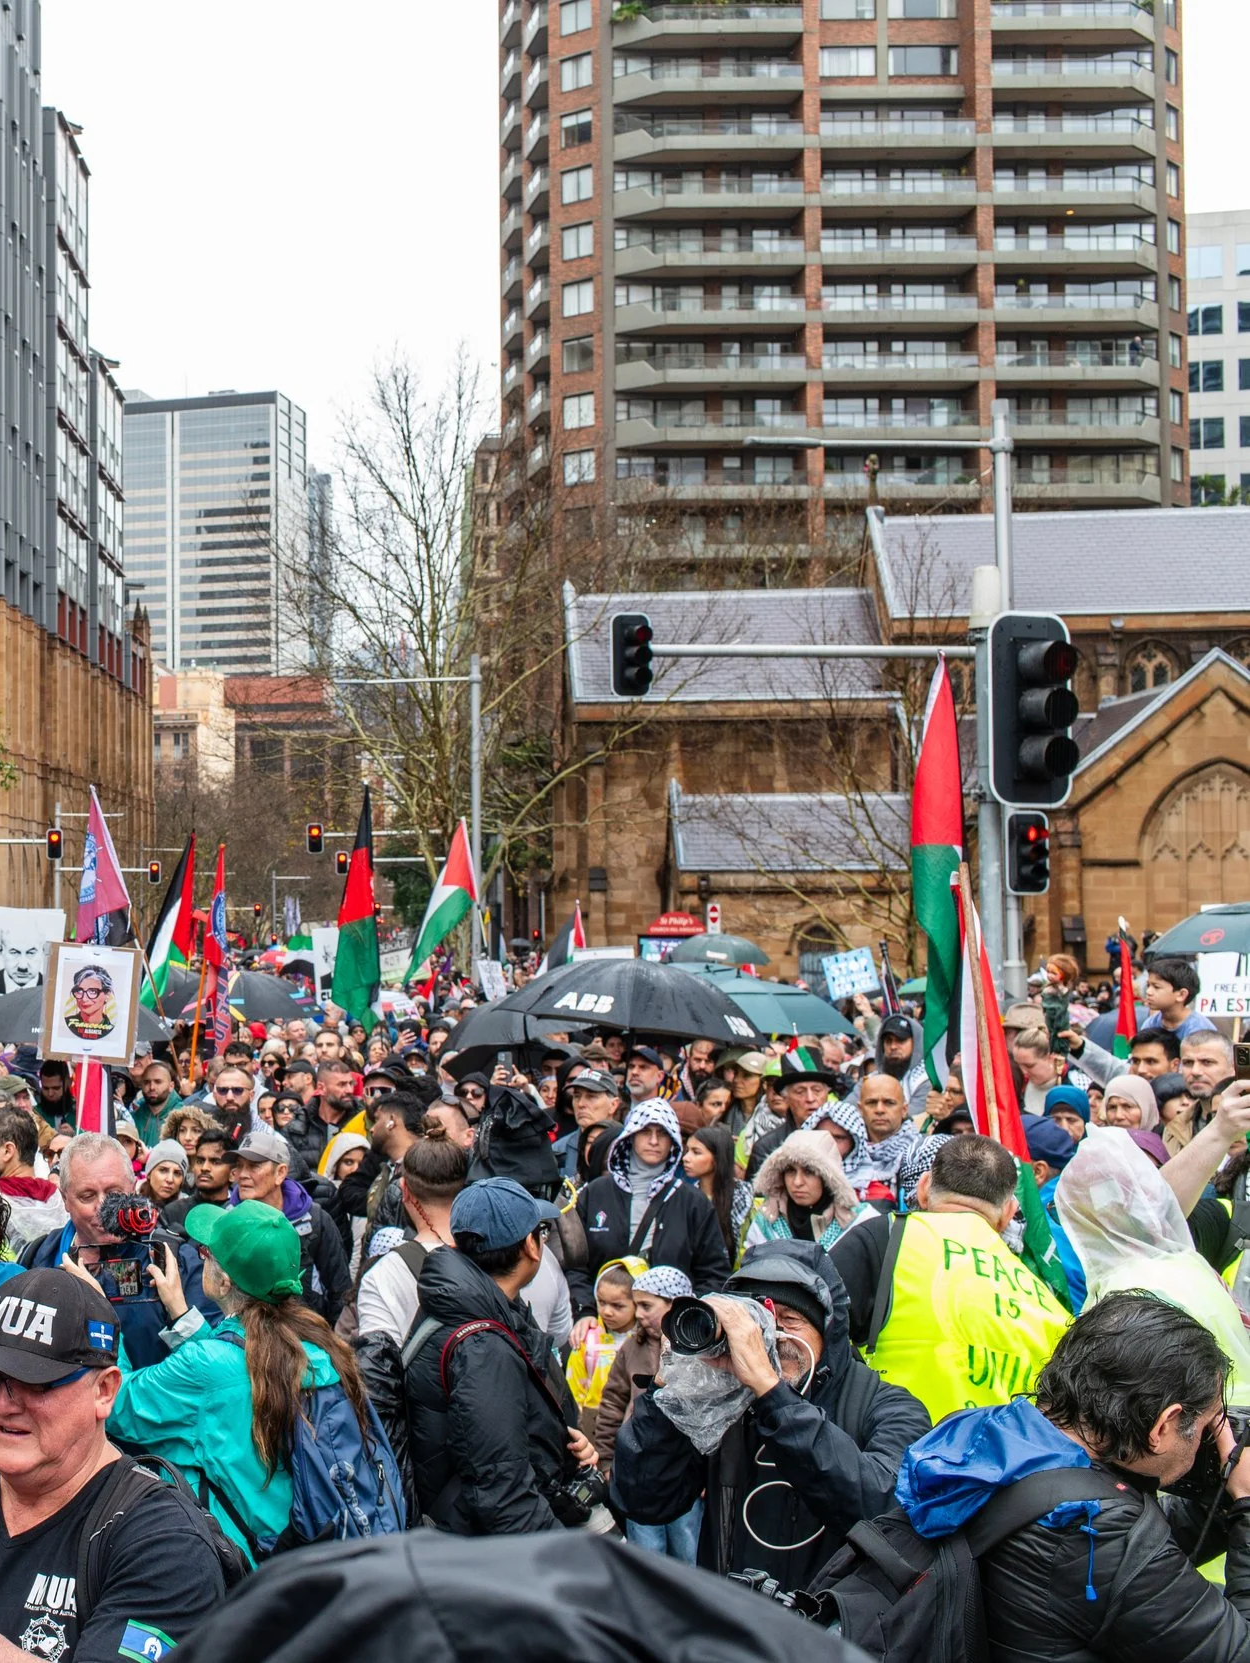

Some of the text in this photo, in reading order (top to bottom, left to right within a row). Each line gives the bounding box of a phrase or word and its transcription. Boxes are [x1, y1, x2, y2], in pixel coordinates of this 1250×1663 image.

[1214, 983, 1238, 993] FREE
[554, 992, 614, 1014] ABB
[943, 1238, 1053, 1312] PEACE
[456, 1322, 490, 1338] Canon
[26, 1573, 77, 1612] MUA
